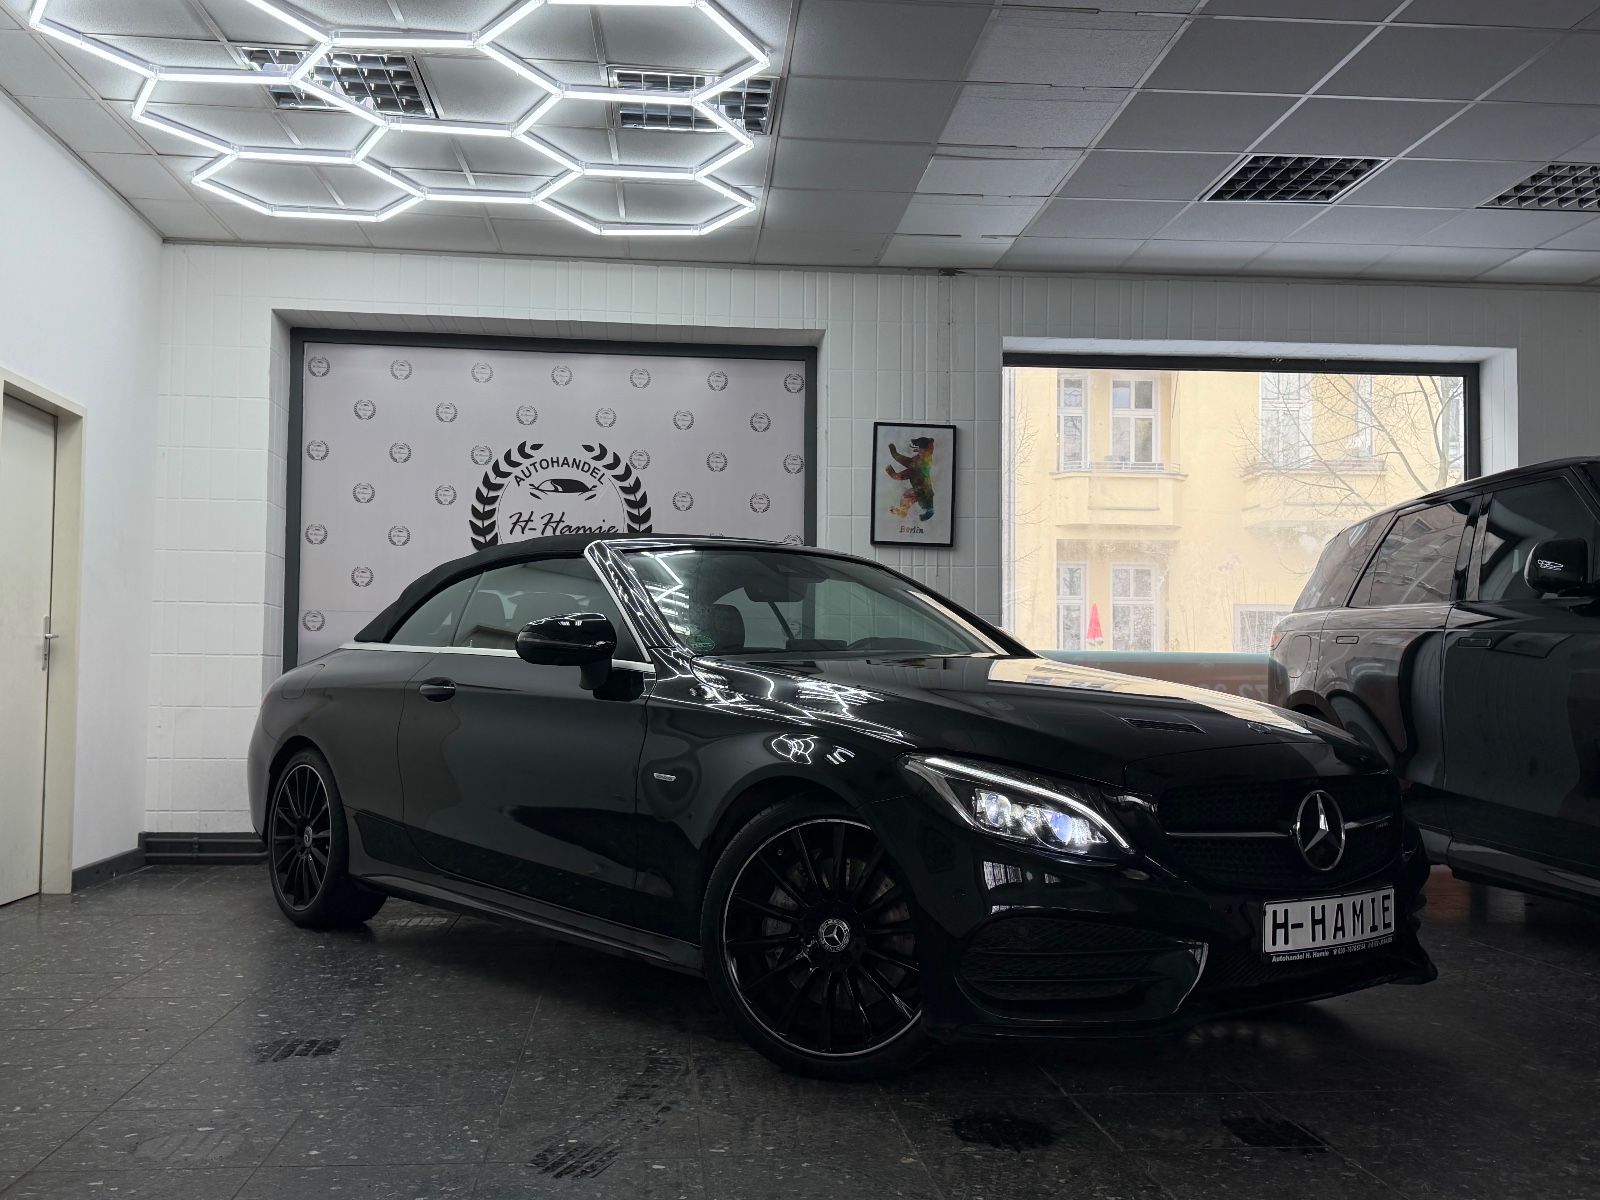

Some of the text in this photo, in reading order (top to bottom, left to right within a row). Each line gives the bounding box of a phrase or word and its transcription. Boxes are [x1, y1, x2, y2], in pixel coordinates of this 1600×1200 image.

[513, 456, 606, 486] AUTOHANDEL
[509, 511, 619, 535] H-Hamie
[899, 525, 925, 534] Berlin
[1271, 894, 1392, 946] H-HAMIE
